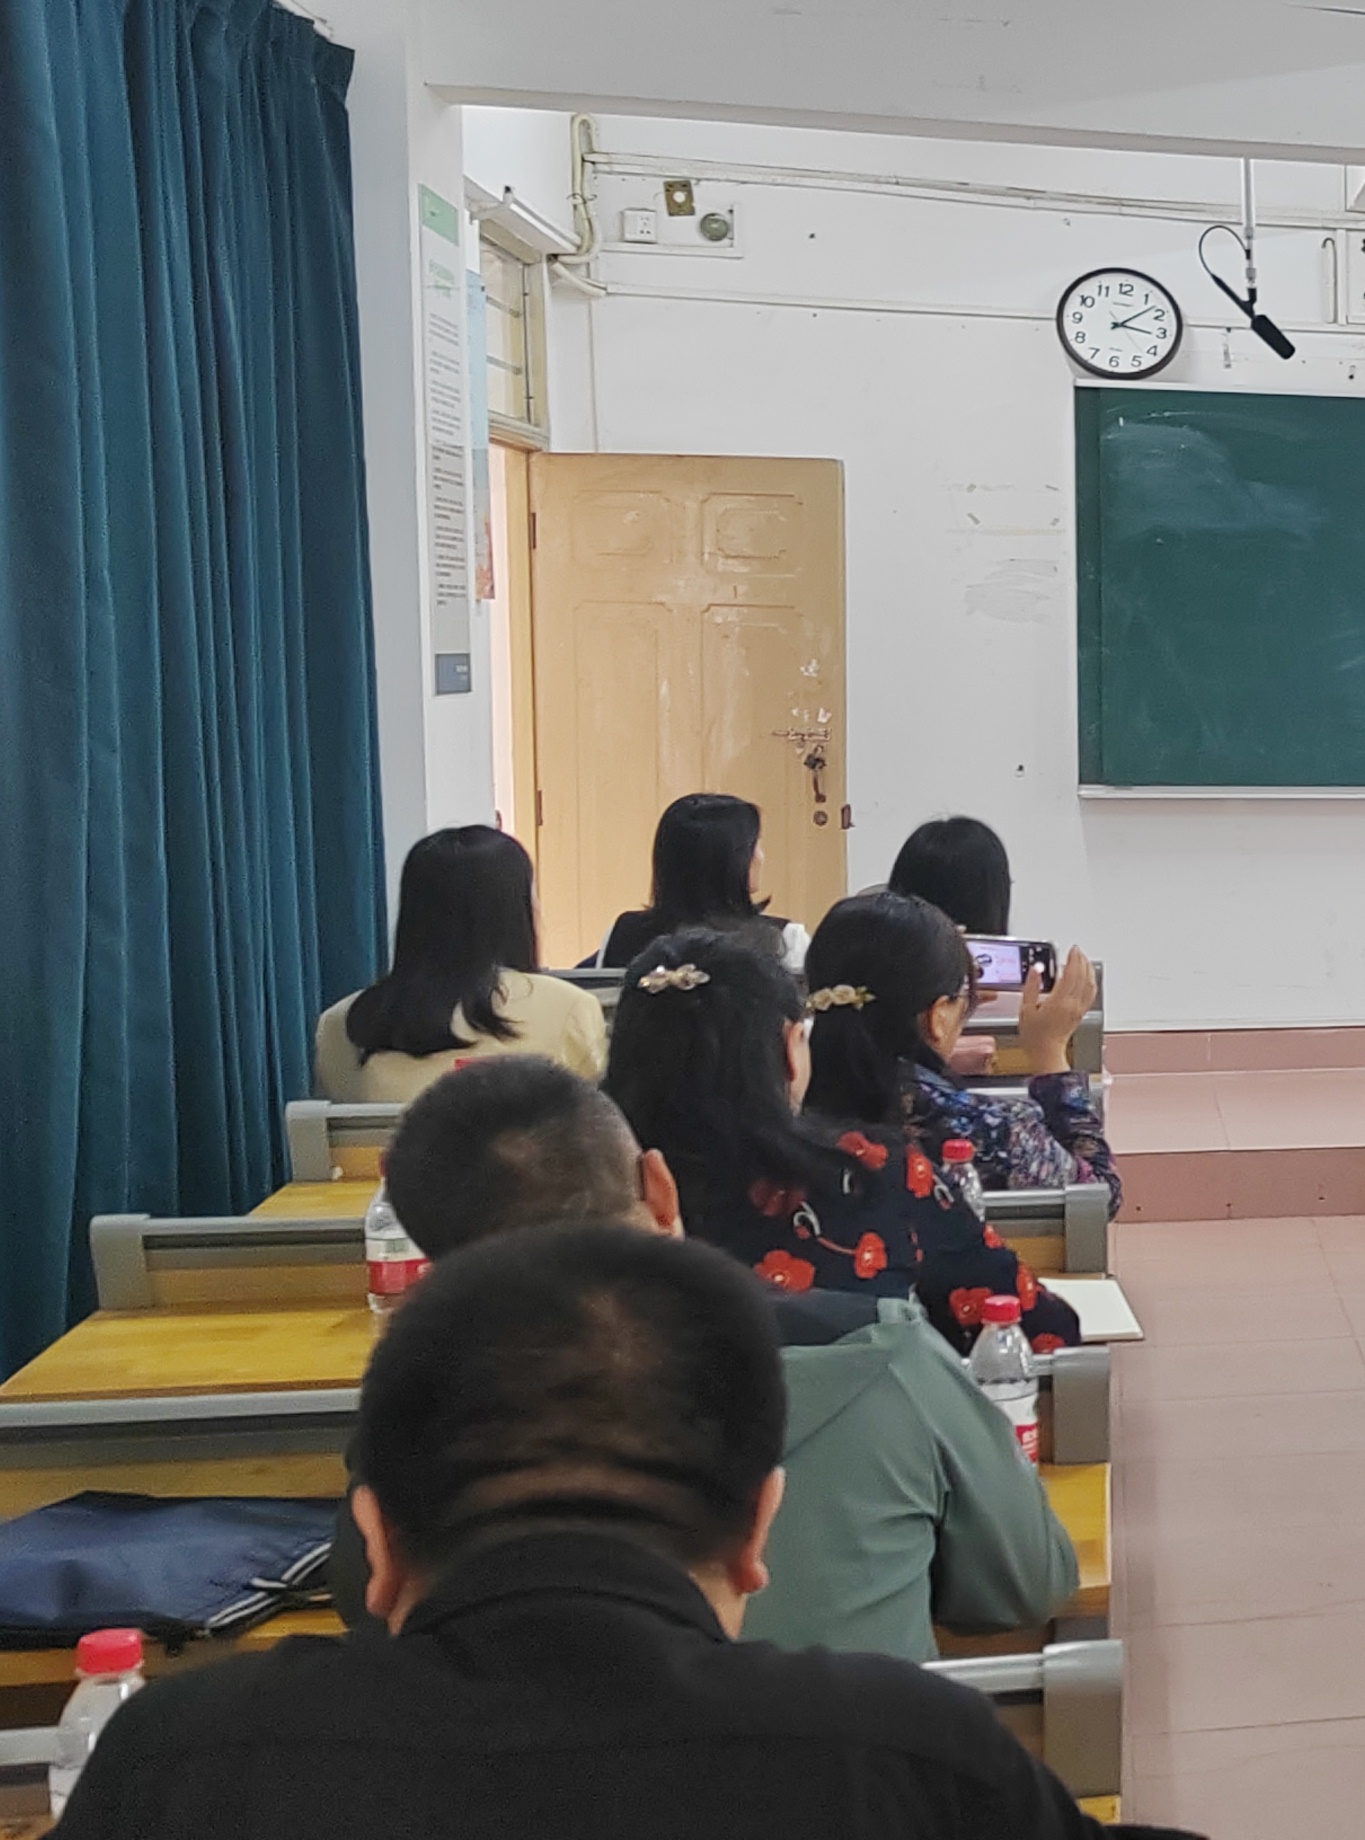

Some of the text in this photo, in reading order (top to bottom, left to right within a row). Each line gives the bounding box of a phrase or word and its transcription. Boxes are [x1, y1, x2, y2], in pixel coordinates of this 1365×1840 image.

[1097, 284, 1110, 298] 11
[1119, 283, 1134, 297] 12
[1080, 295, 1095, 308] 10
[1144, 293, 1149, 305] 1
[1072, 311, 1083, 324] 9
[1153, 309, 1166, 321] 2
[1074, 331, 1086, 344] 8
[1155, 327, 1167, 339] 3
[1088, 347, 1101, 359] 7
[1146, 345, 1158, 357] 4
[1109, 355, 1120, 368] 6
[1131, 355, 1143, 367] 5
